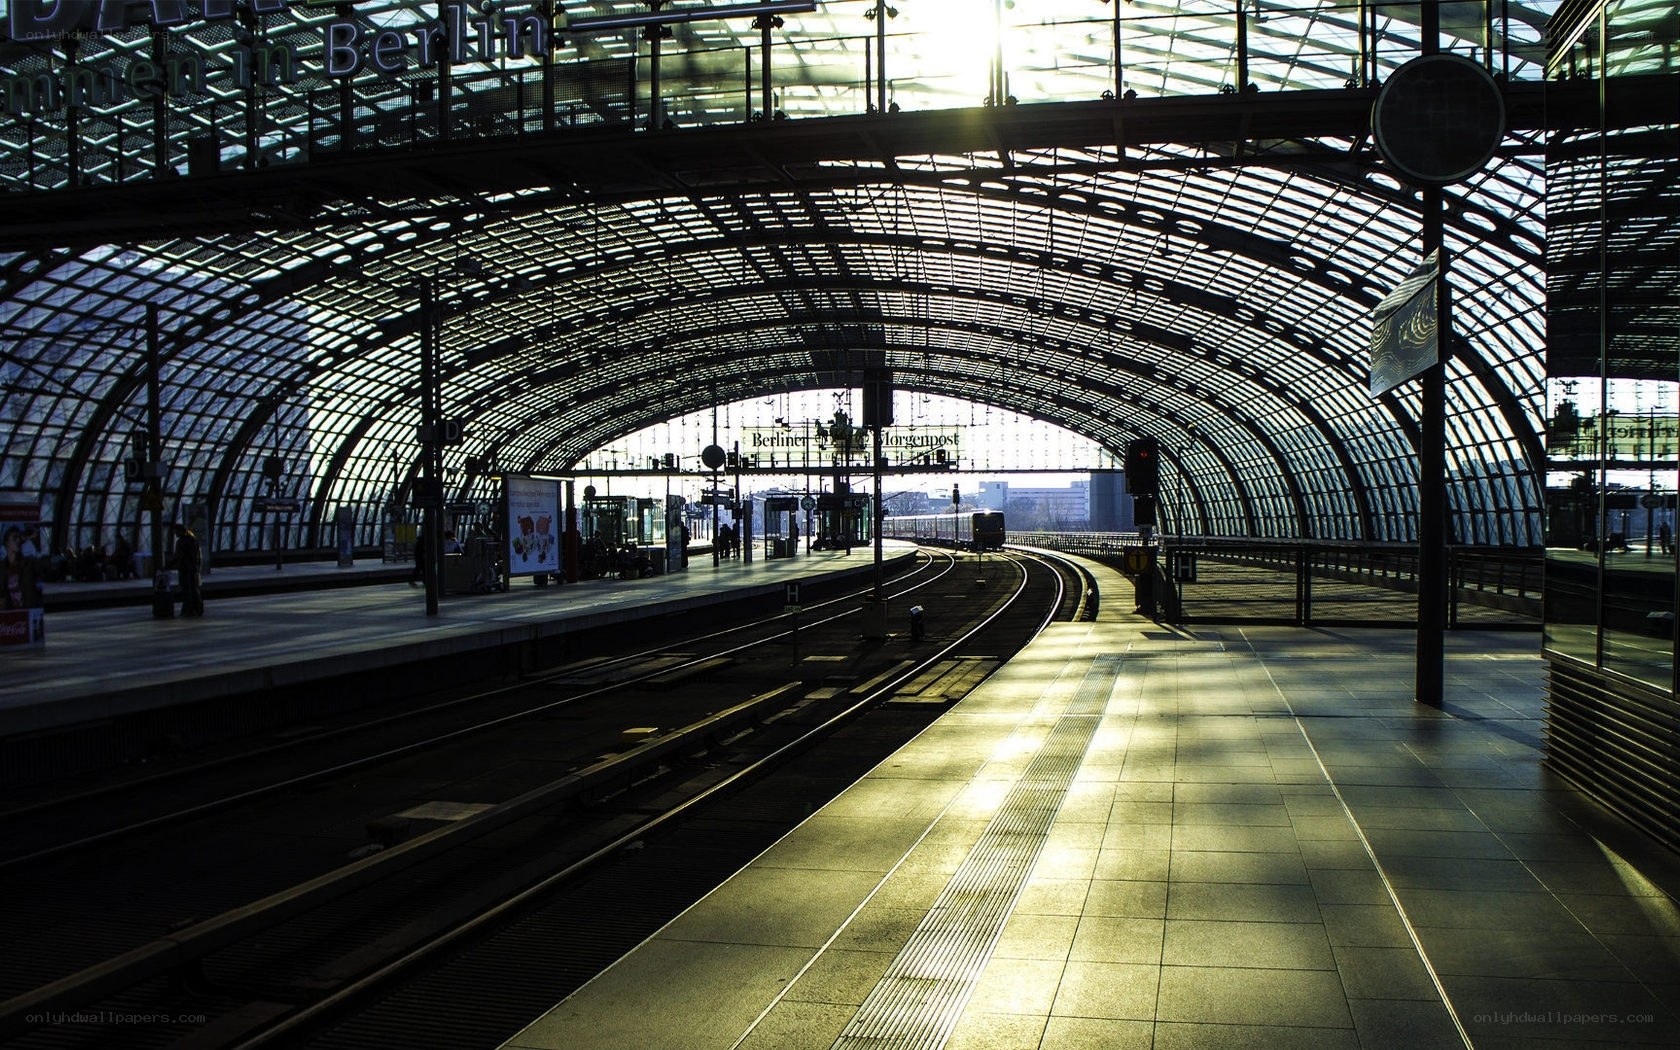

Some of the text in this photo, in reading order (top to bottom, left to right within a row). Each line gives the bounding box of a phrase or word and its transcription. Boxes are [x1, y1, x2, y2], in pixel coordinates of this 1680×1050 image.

[324, 1, 551, 77] Berlin
[446, 421, 460, 440] D
[752, 433, 807, 448] Berliner
[127, 460, 139, 478] D
[1178, 556, 1194, 579] H
[786, 584, 799, 602] H
